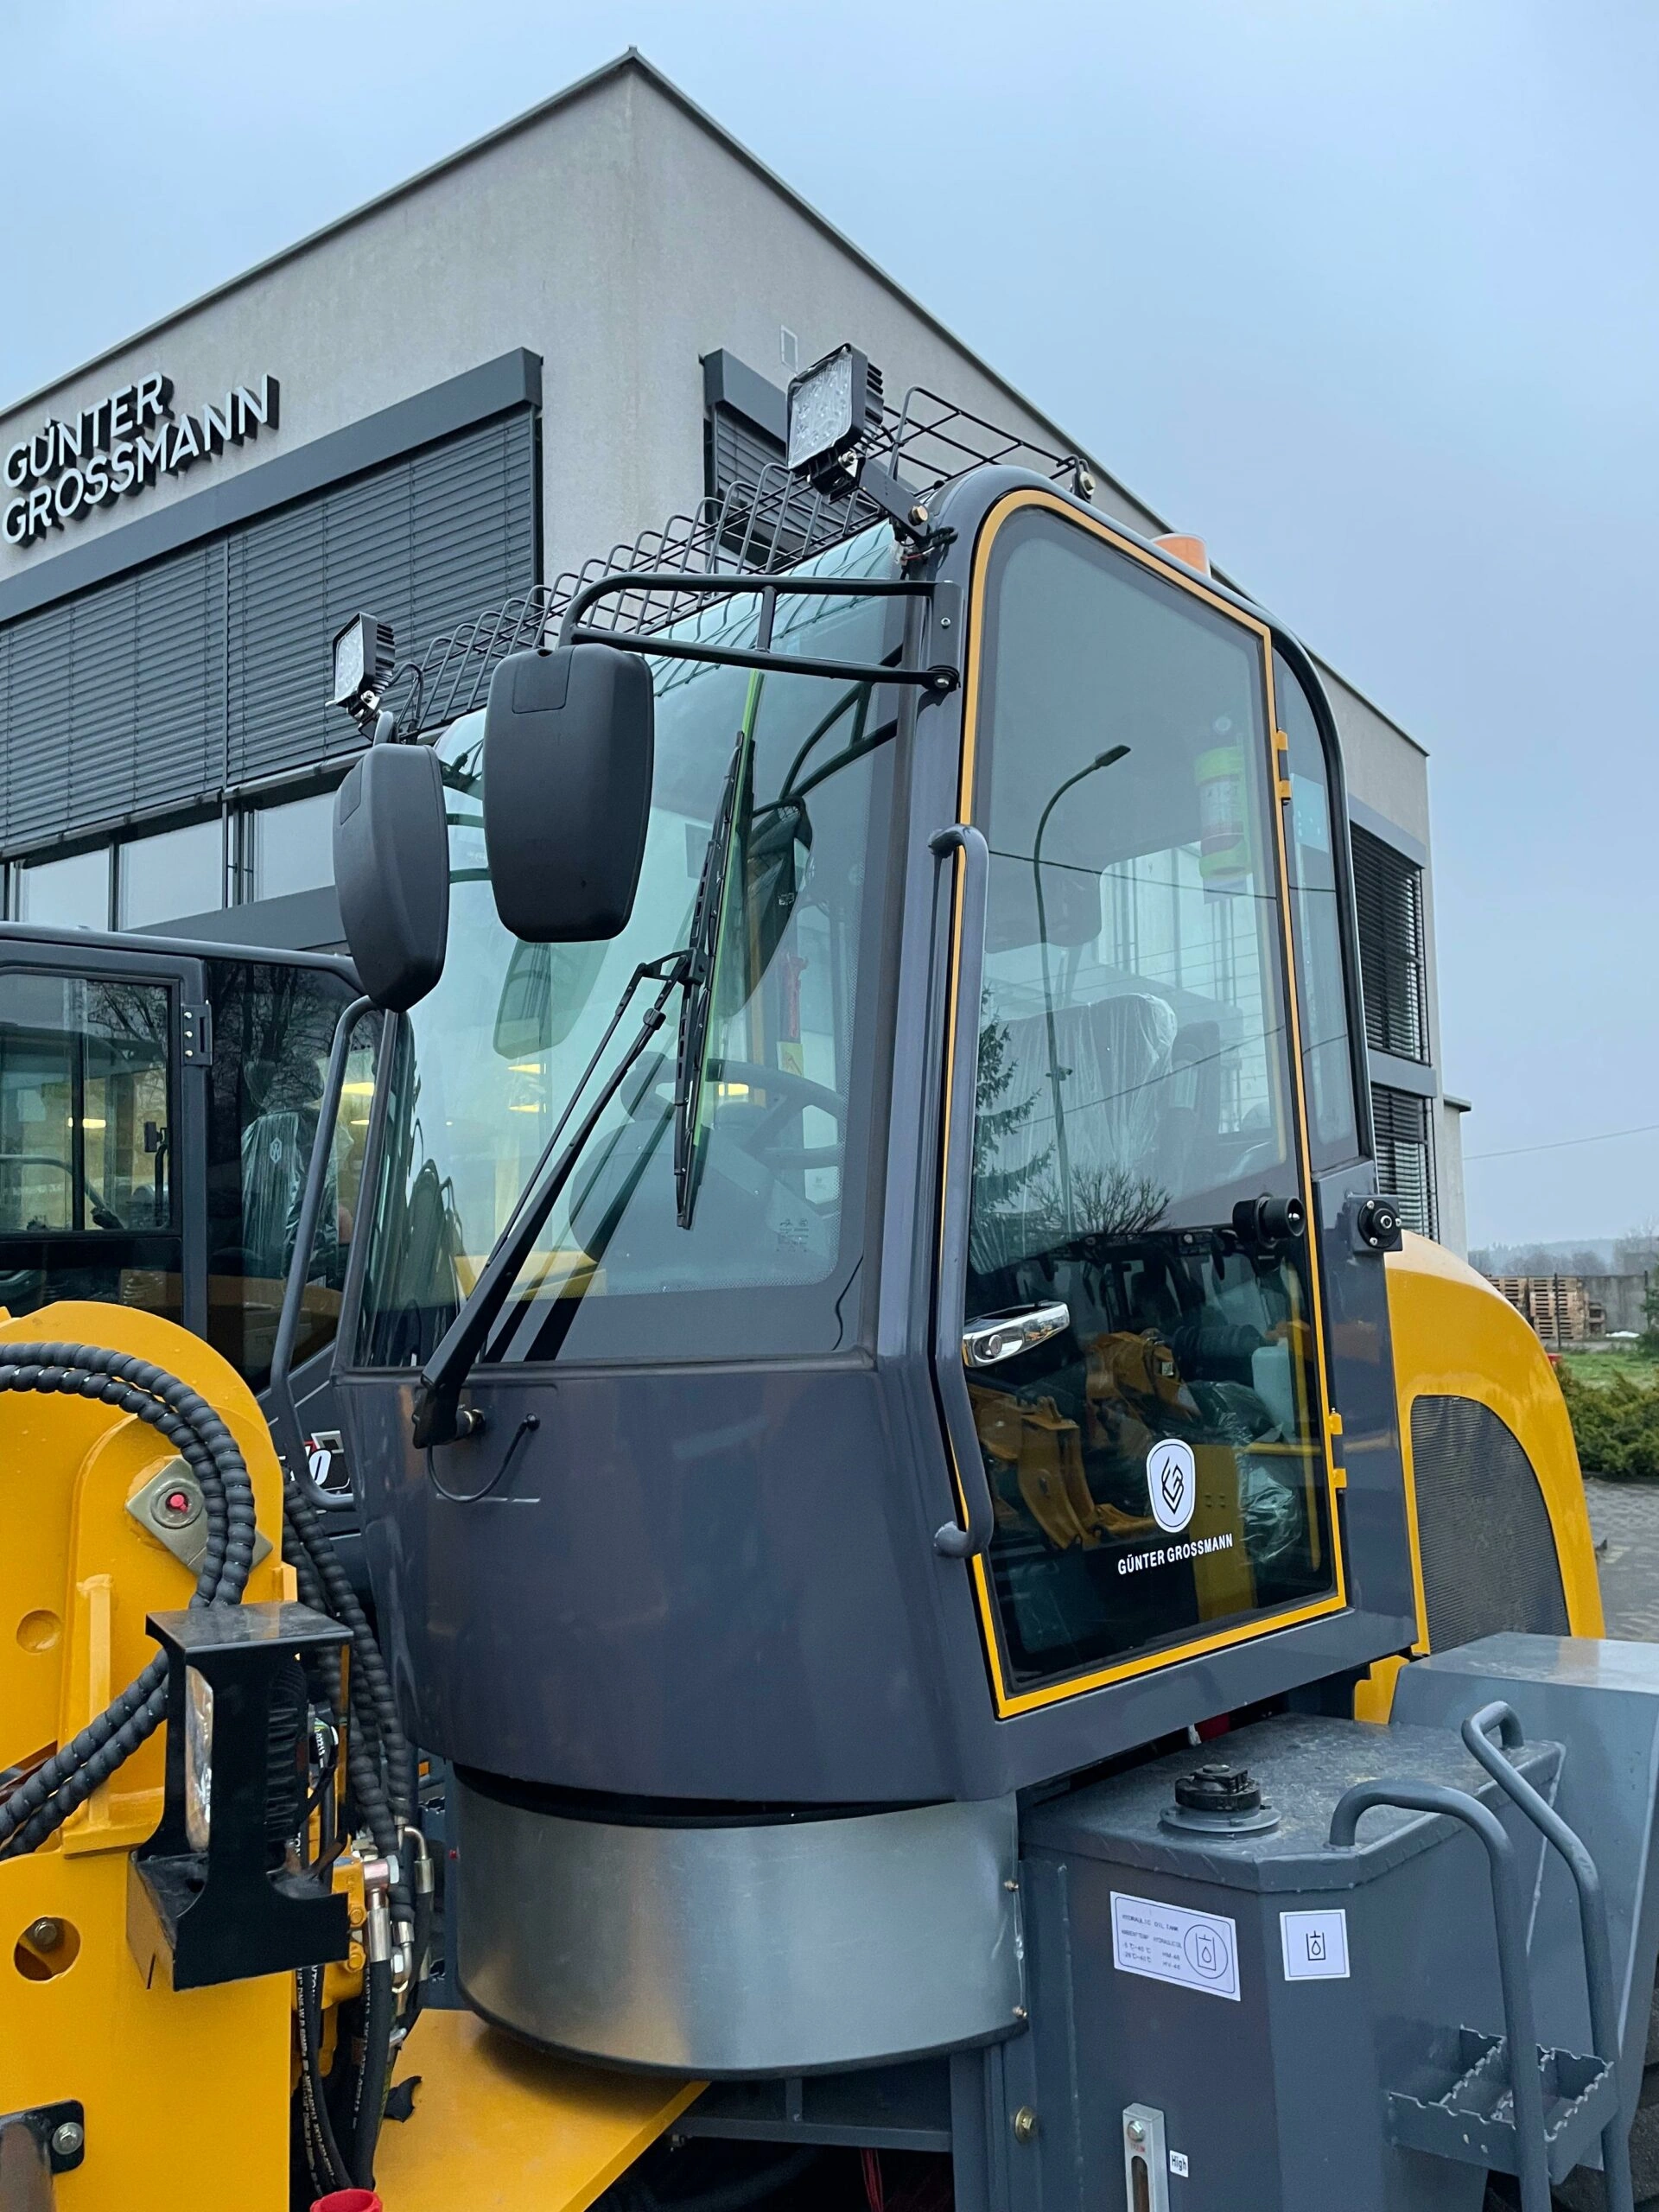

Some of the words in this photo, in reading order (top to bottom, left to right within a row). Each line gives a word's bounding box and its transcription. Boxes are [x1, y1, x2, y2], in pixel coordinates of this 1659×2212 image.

[2, 373, 276, 545] GROSSMANN
[5, 372, 170, 489] GÜNTER
[1117, 1549, 1165, 1575] GÜNTER
[1166, 1533, 1233, 1563] GROSSMANN
[1171, 2154, 1187, 2171] High
